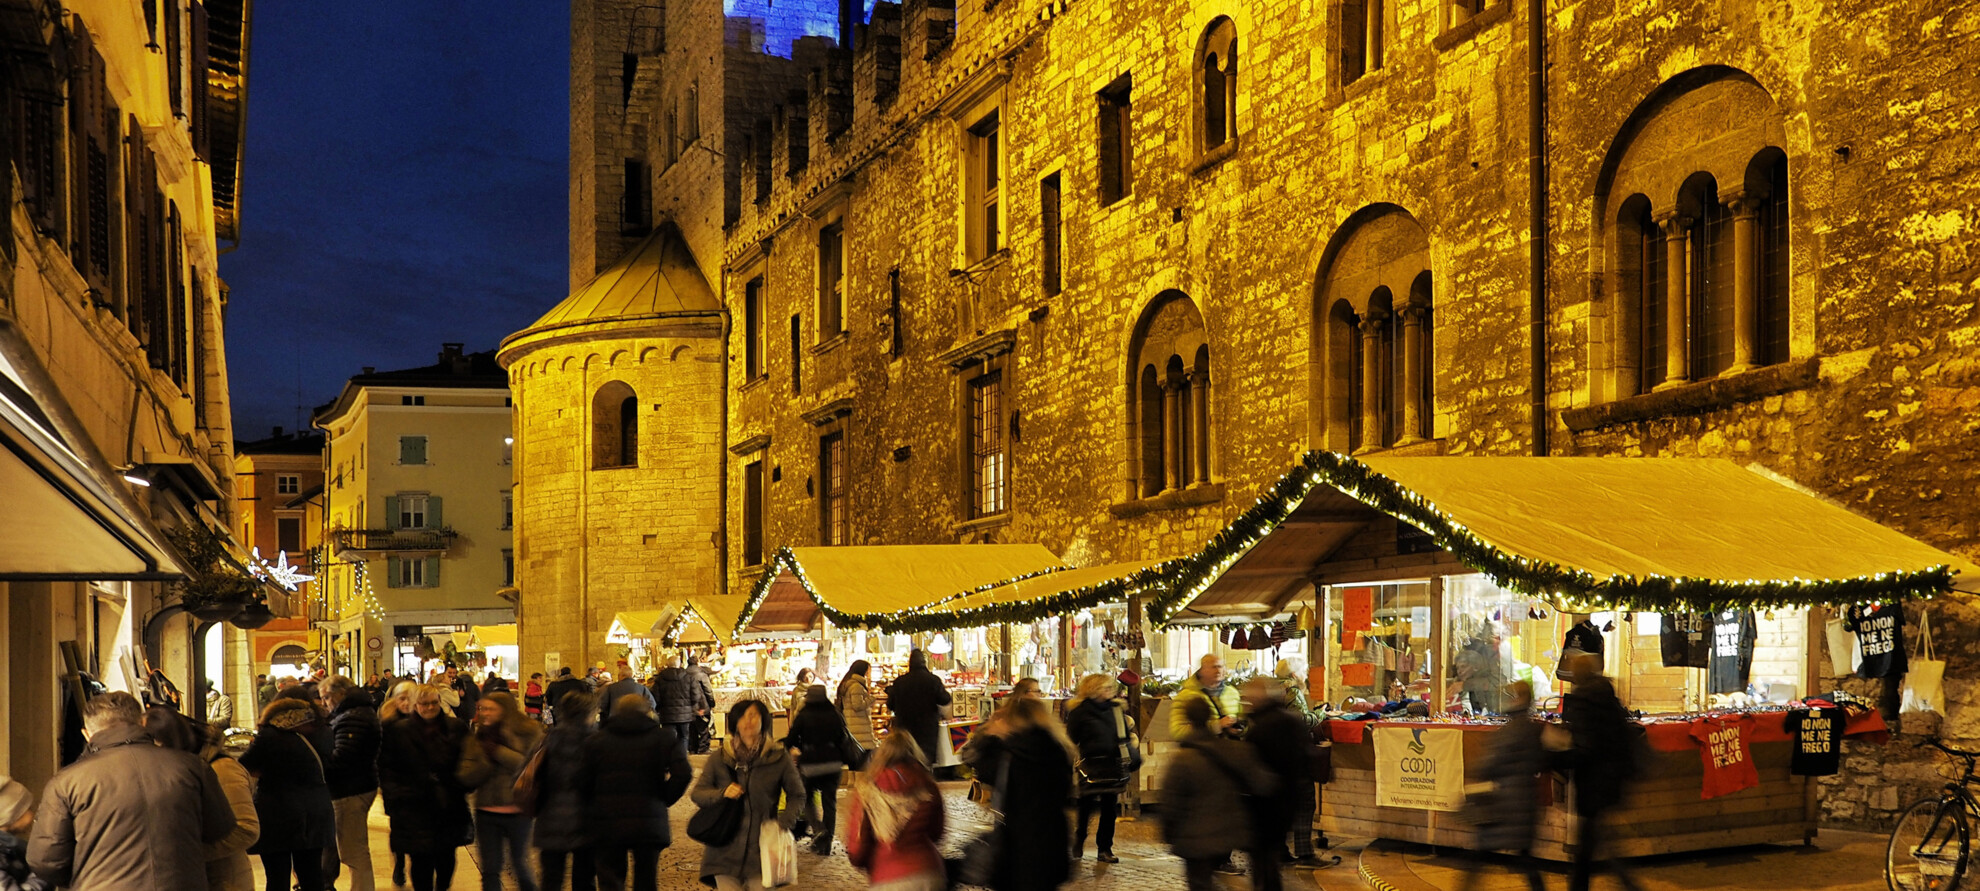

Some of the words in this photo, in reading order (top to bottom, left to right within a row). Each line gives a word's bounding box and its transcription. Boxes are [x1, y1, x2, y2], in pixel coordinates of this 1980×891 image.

[1860, 620, 1871, 632] IO
[1872, 616, 1894, 630] NON
[1716, 632, 1729, 646] ME
[1861, 631, 1878, 644] ME
[1881, 628, 1894, 641] NE
[1717, 645, 1737, 657] FREG
[1862, 640, 1894, 656] FREGO
[1802, 719, 1811, 730] IO
[1812, 718, 1831, 730] NON
[1708, 732, 1719, 745] IO
[1720, 726, 1740, 743] NON
[1801, 731, 1815, 742] ME
[1817, 730, 1830, 741] NE
[1710, 743, 1725, 757] ME
[1728, 738, 1740, 752] NE
[1802, 742, 1830, 753] FREGO
[1400, 757, 1436, 777] COOPI
[1713, 750, 1743, 769] FREGO
